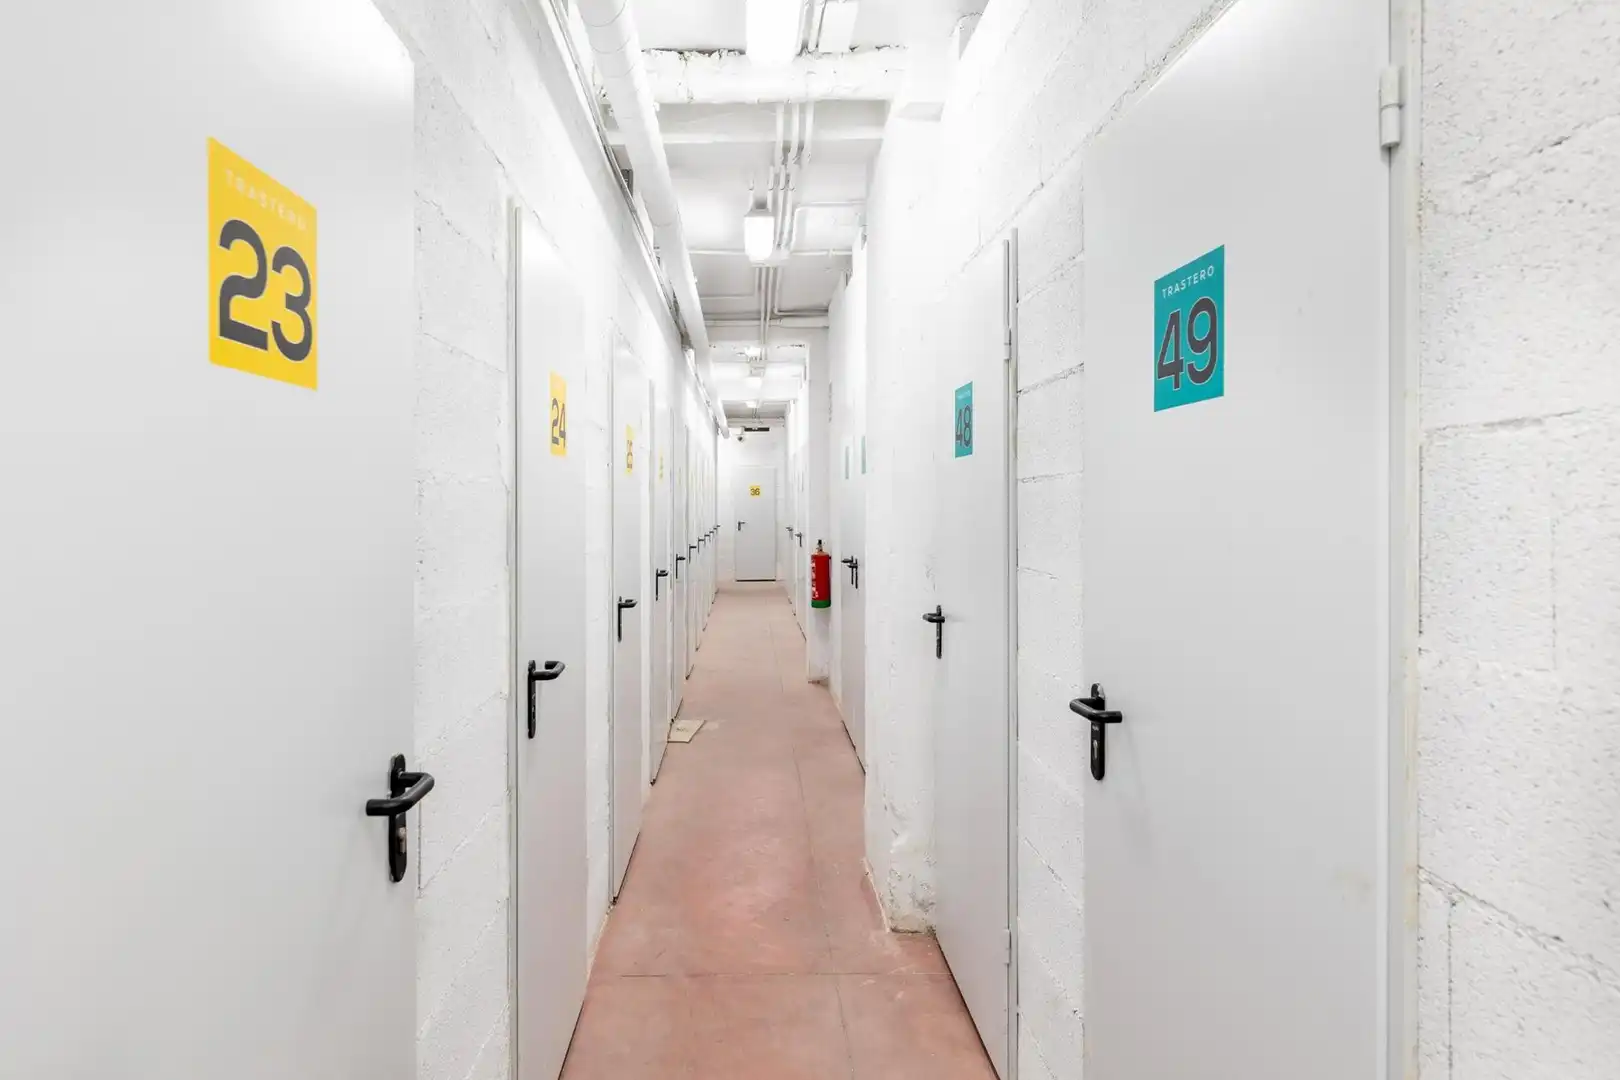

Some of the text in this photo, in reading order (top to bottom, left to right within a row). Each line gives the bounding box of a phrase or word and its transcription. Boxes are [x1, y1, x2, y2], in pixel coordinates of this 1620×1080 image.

[219, 218, 313, 362] 23
[1162, 265, 1215, 298] TRASTERO
[1157, 296, 1218, 391] 49
[551, 397, 566, 449] 24
[955, 404, 972, 447] 48
[750, 487, 760, 496] 36
